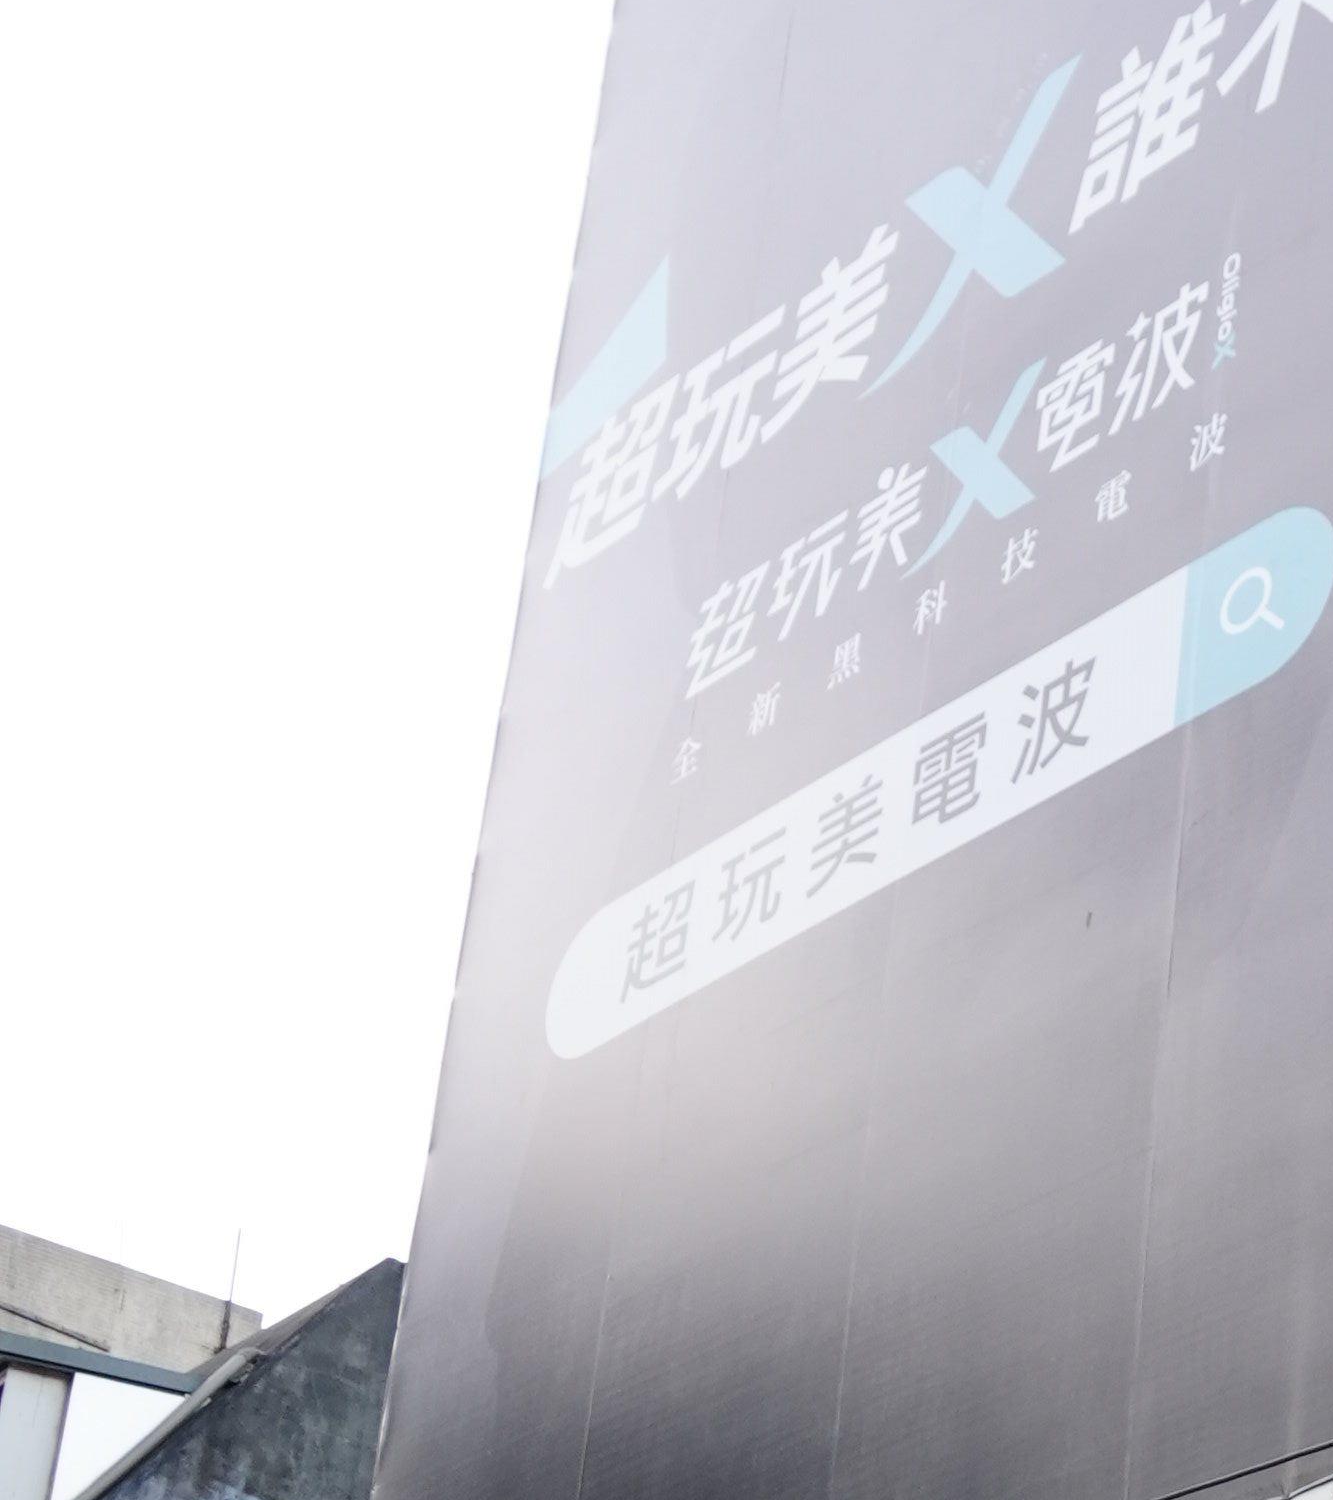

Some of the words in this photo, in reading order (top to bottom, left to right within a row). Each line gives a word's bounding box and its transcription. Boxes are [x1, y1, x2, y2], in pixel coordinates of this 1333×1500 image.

[619, 655, 1098, 1003] 超玩美電波
